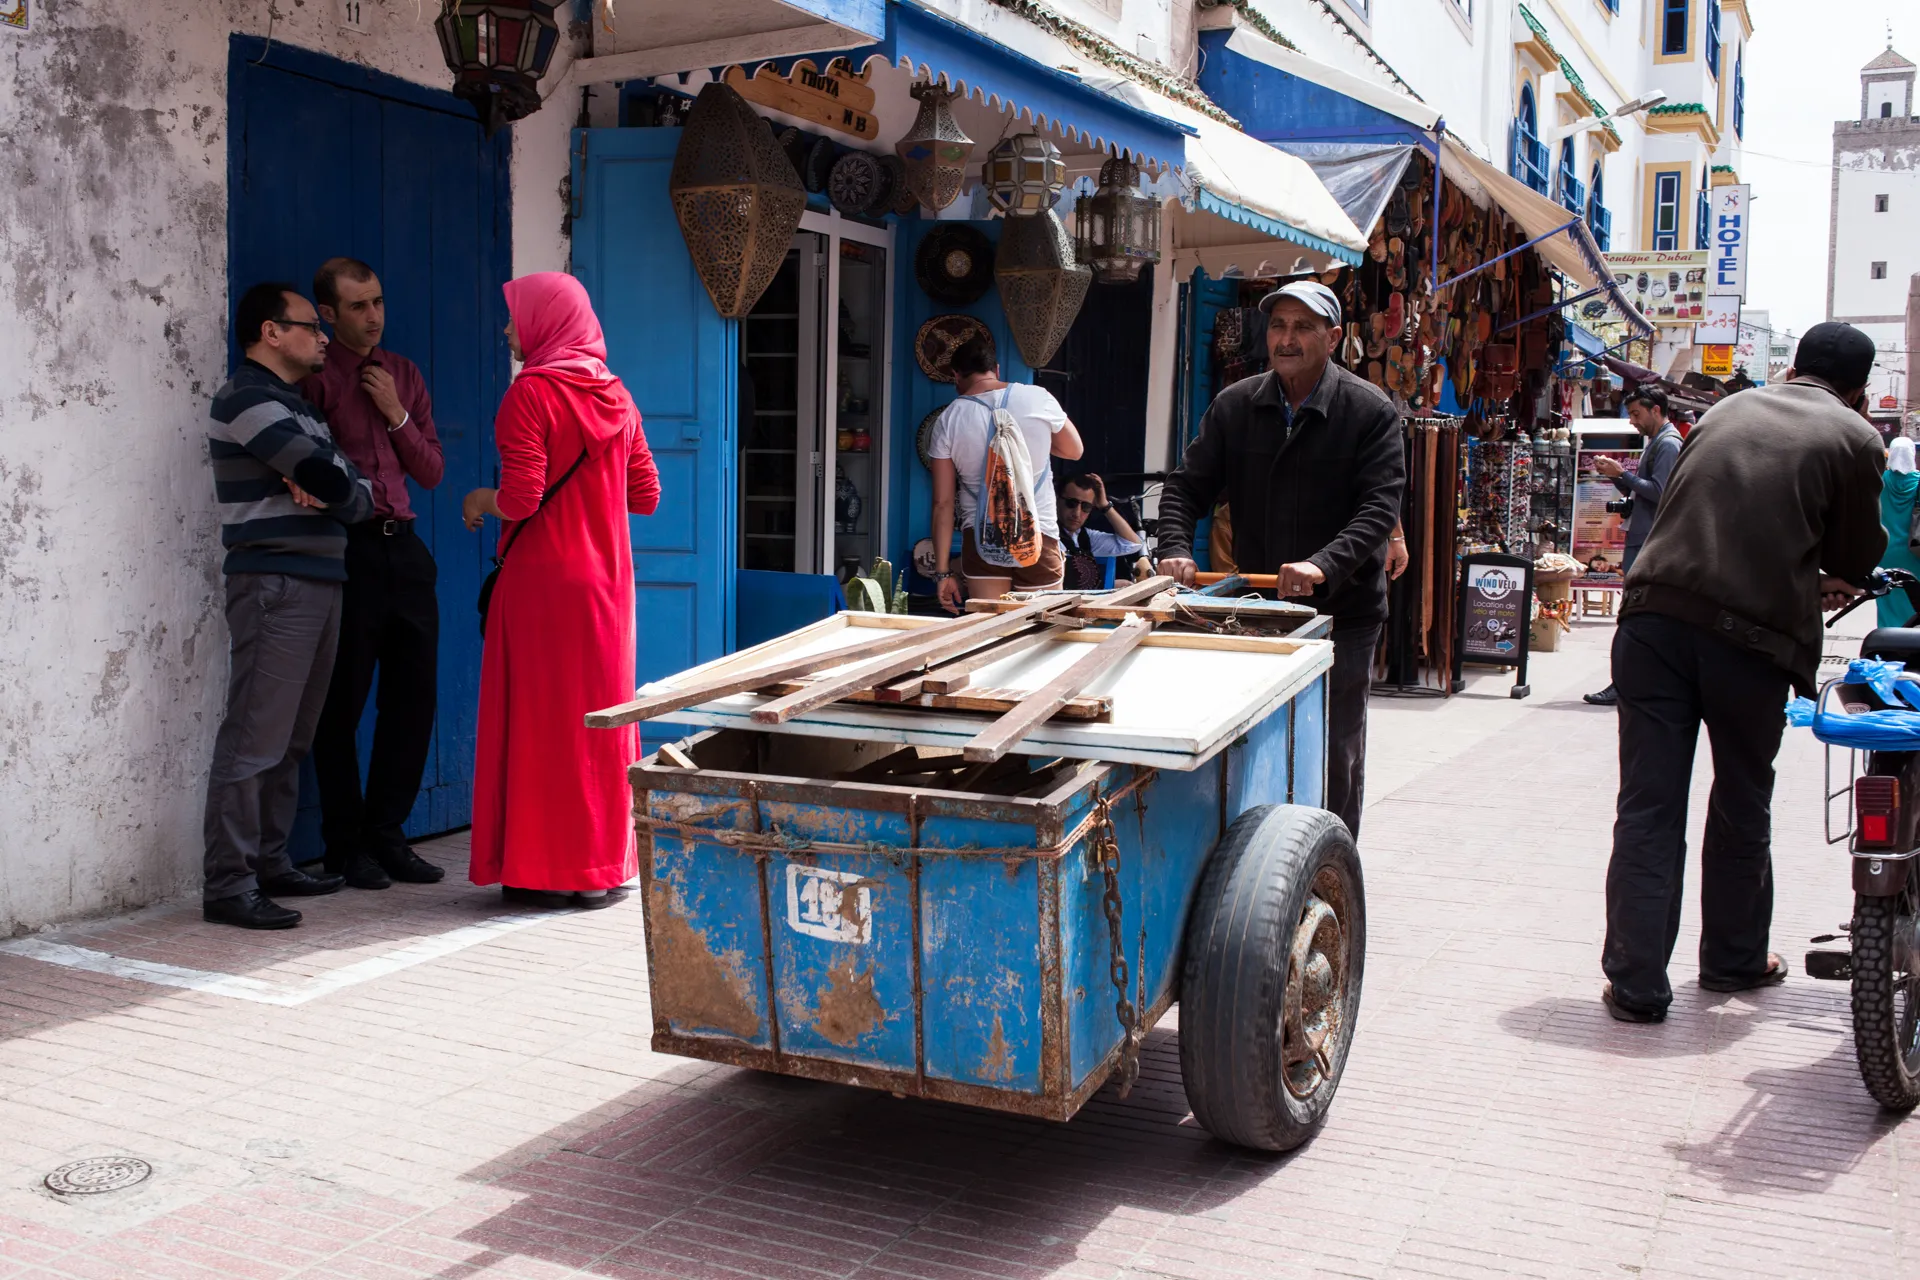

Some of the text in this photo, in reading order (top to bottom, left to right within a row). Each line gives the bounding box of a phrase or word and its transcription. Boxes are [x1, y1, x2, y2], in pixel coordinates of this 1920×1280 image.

[345, 1, 360, 25] 11
[801, 67, 839, 97] THUYA
[1602, 252, 1693, 264] Boutique Dubai
[1718, 214, 1741, 285] HOTEL
[1475, 578, 1517, 590] WIND VELO
[1473, 600, 1516, 610] Location de
